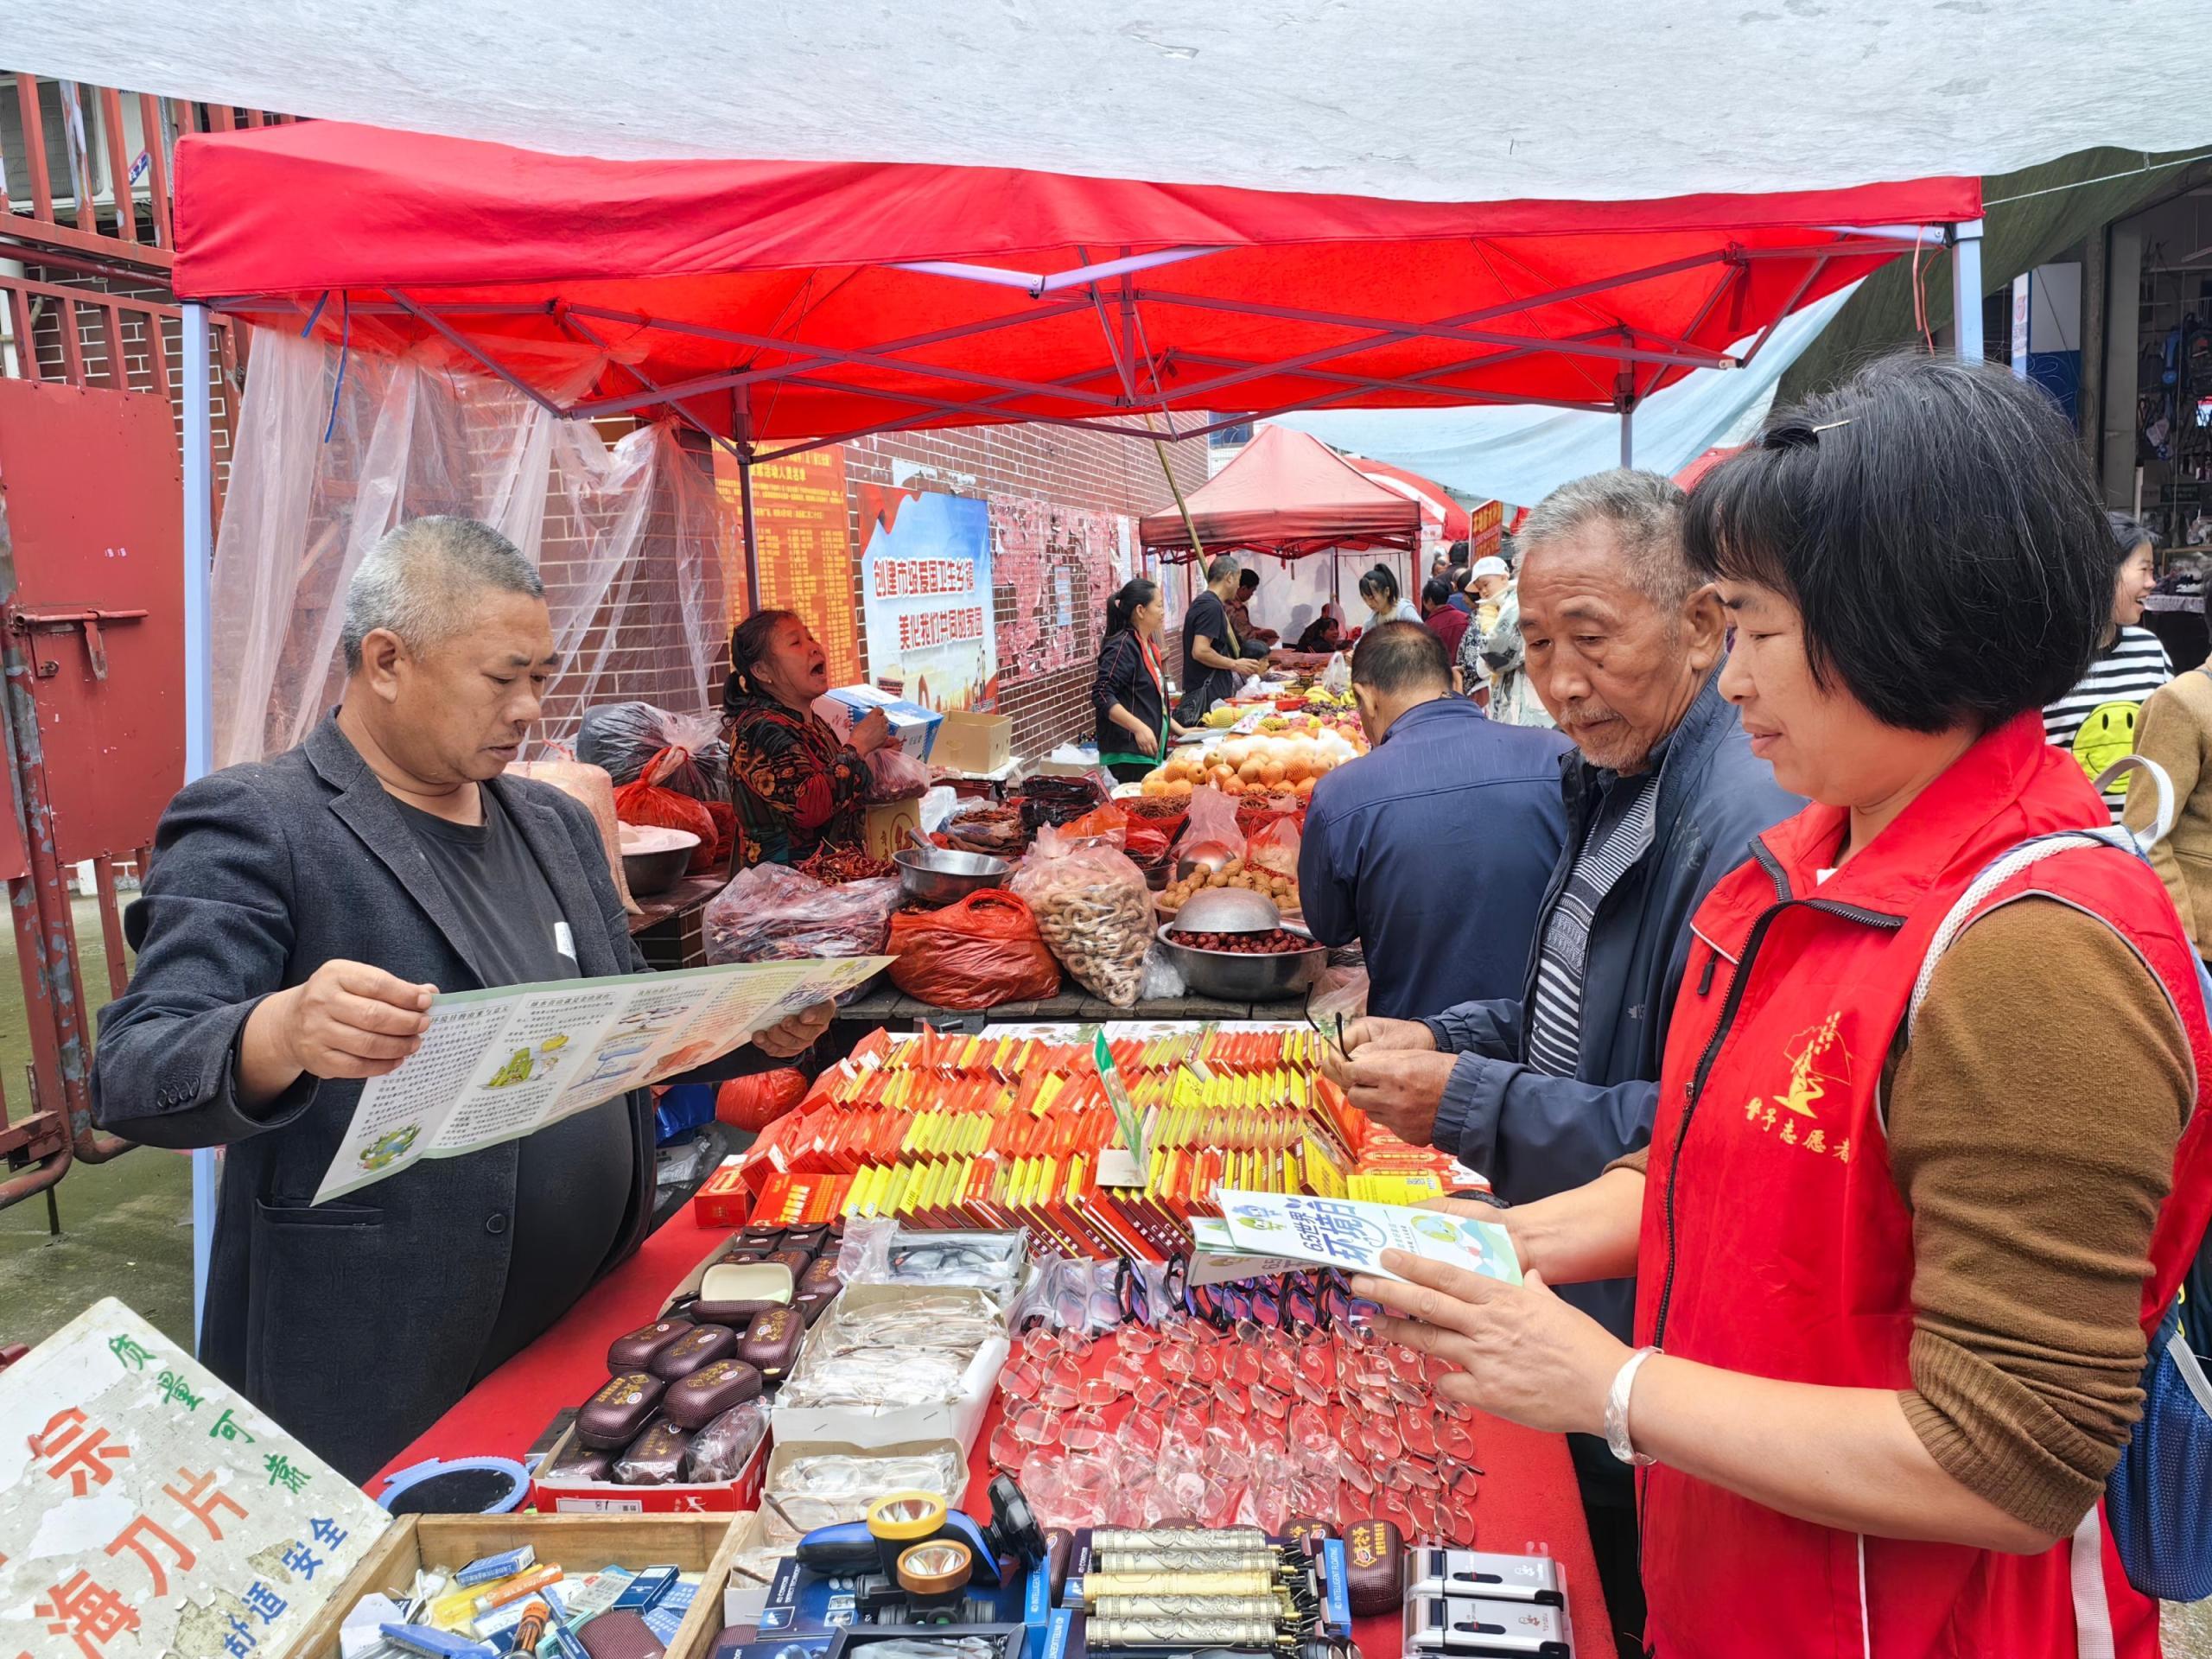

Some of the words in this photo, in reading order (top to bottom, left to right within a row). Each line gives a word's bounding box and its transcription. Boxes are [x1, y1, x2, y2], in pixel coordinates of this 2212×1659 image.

[874, 558, 975, 597] 创建市级爱国卫生乡镇
[899, 607, 983, 650] 美化我们共同的家园
[1289, 1210, 1325, 1252] 6.5世界
[1313, 1200, 1376, 1266] 环境日
[108, 1334, 312, 1494] 质量可靠
[16, 1466, 250, 1658] 海刀片
[223, 1517, 349, 1658] 舒适安全
